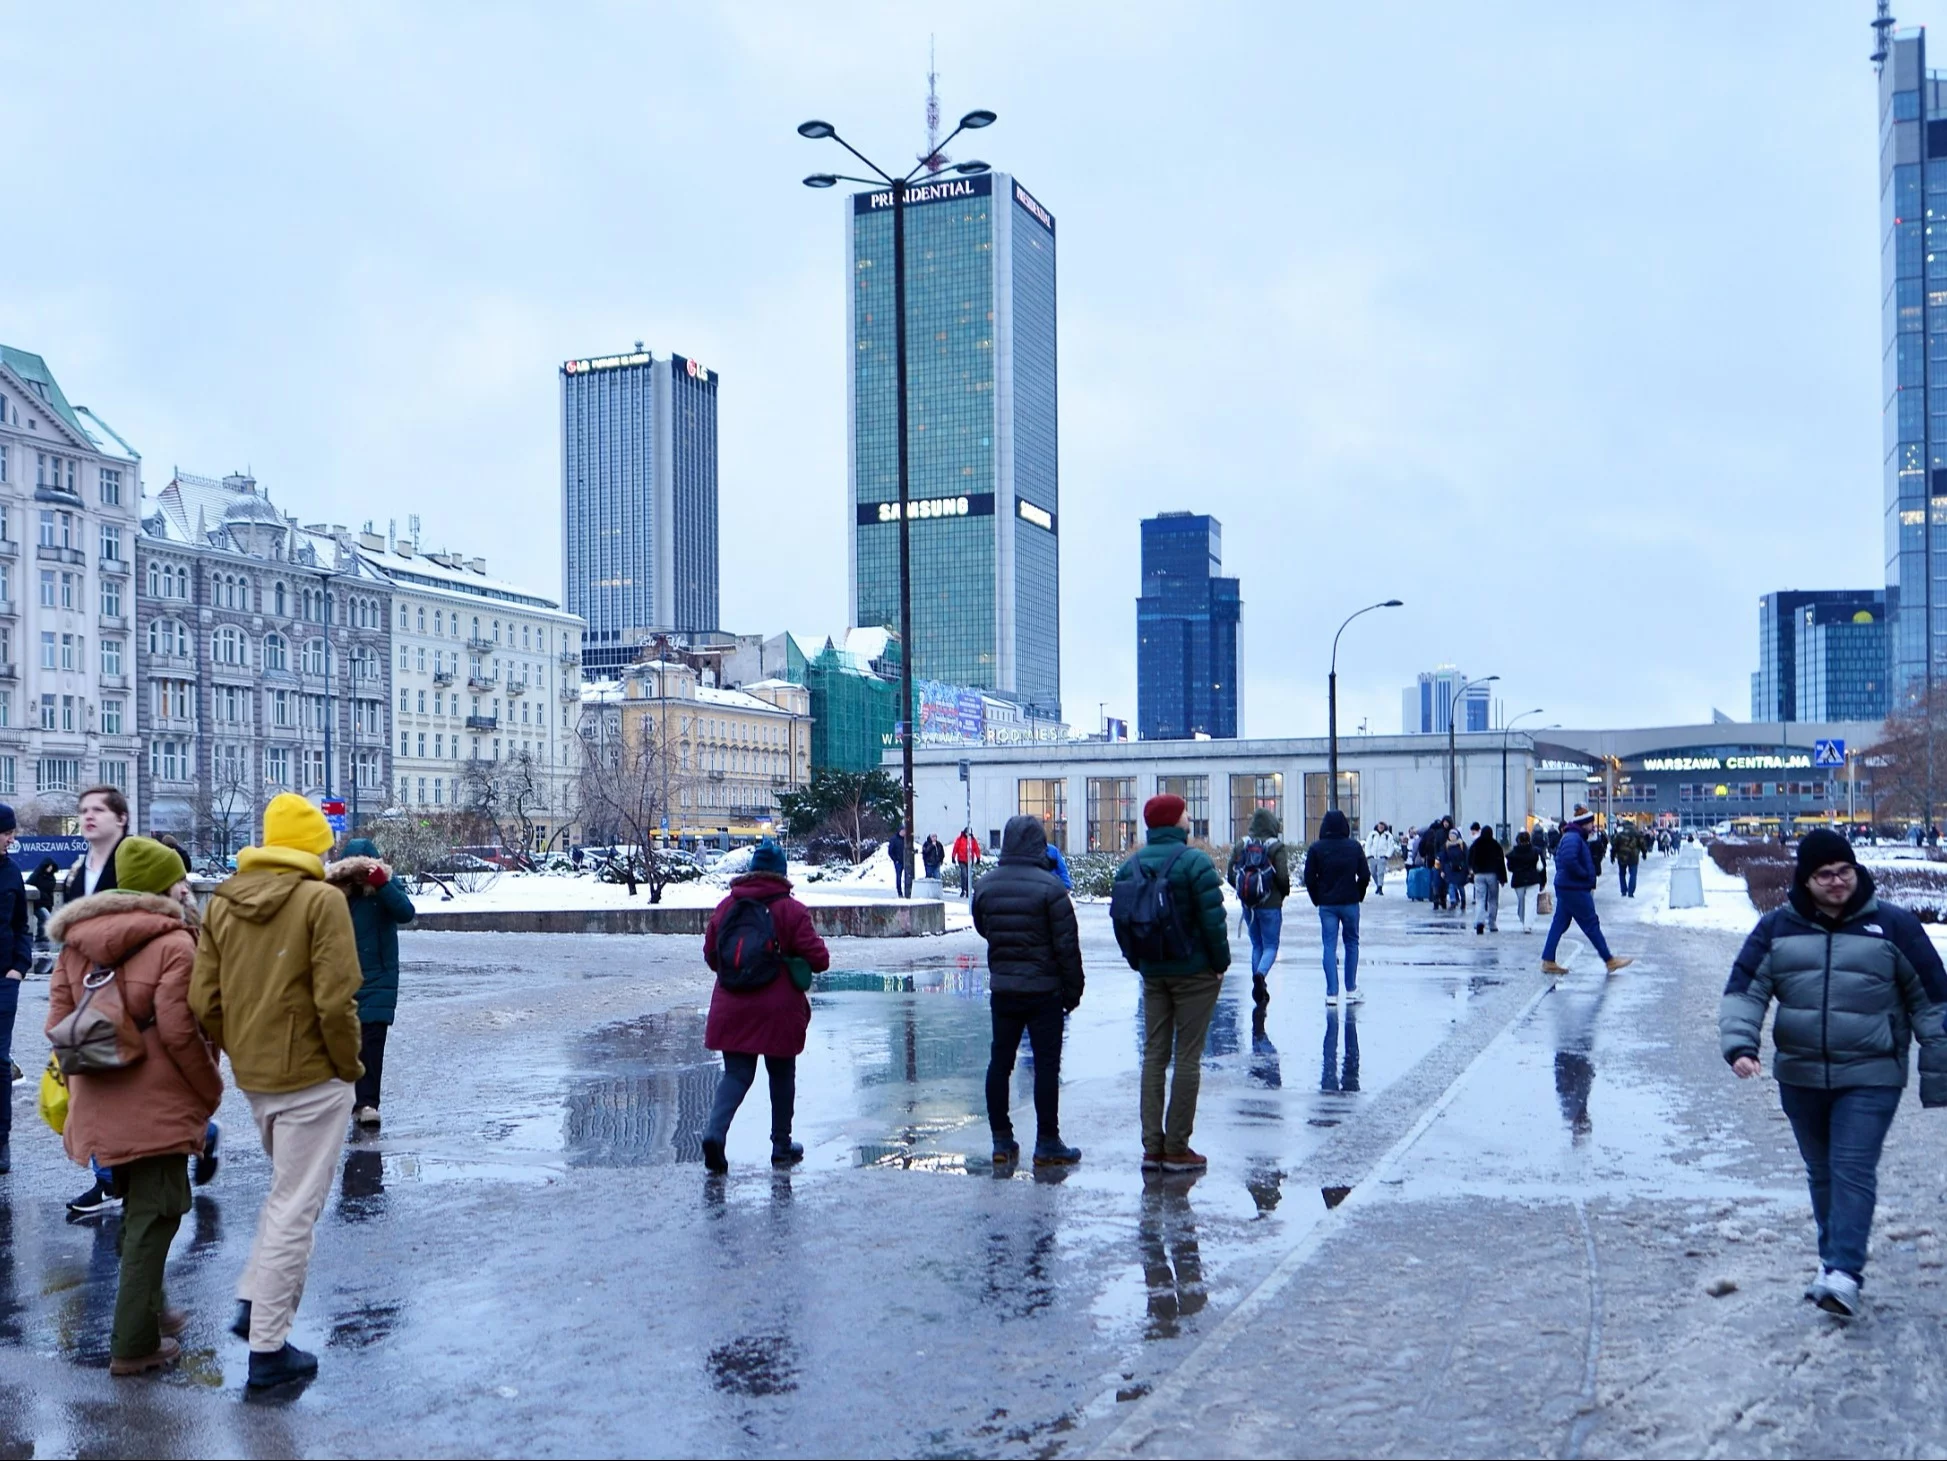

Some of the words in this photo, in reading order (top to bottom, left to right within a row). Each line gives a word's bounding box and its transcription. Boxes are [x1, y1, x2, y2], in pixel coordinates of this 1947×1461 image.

[870, 180, 975, 208] PREIDENTIAL
[879, 496, 969, 521] SAMSUNG
[1644, 757, 1721, 771] WARSZAWA
[1726, 755, 1811, 769] CENTRALNA
[22, 842, 70, 852] WARSZAWA
